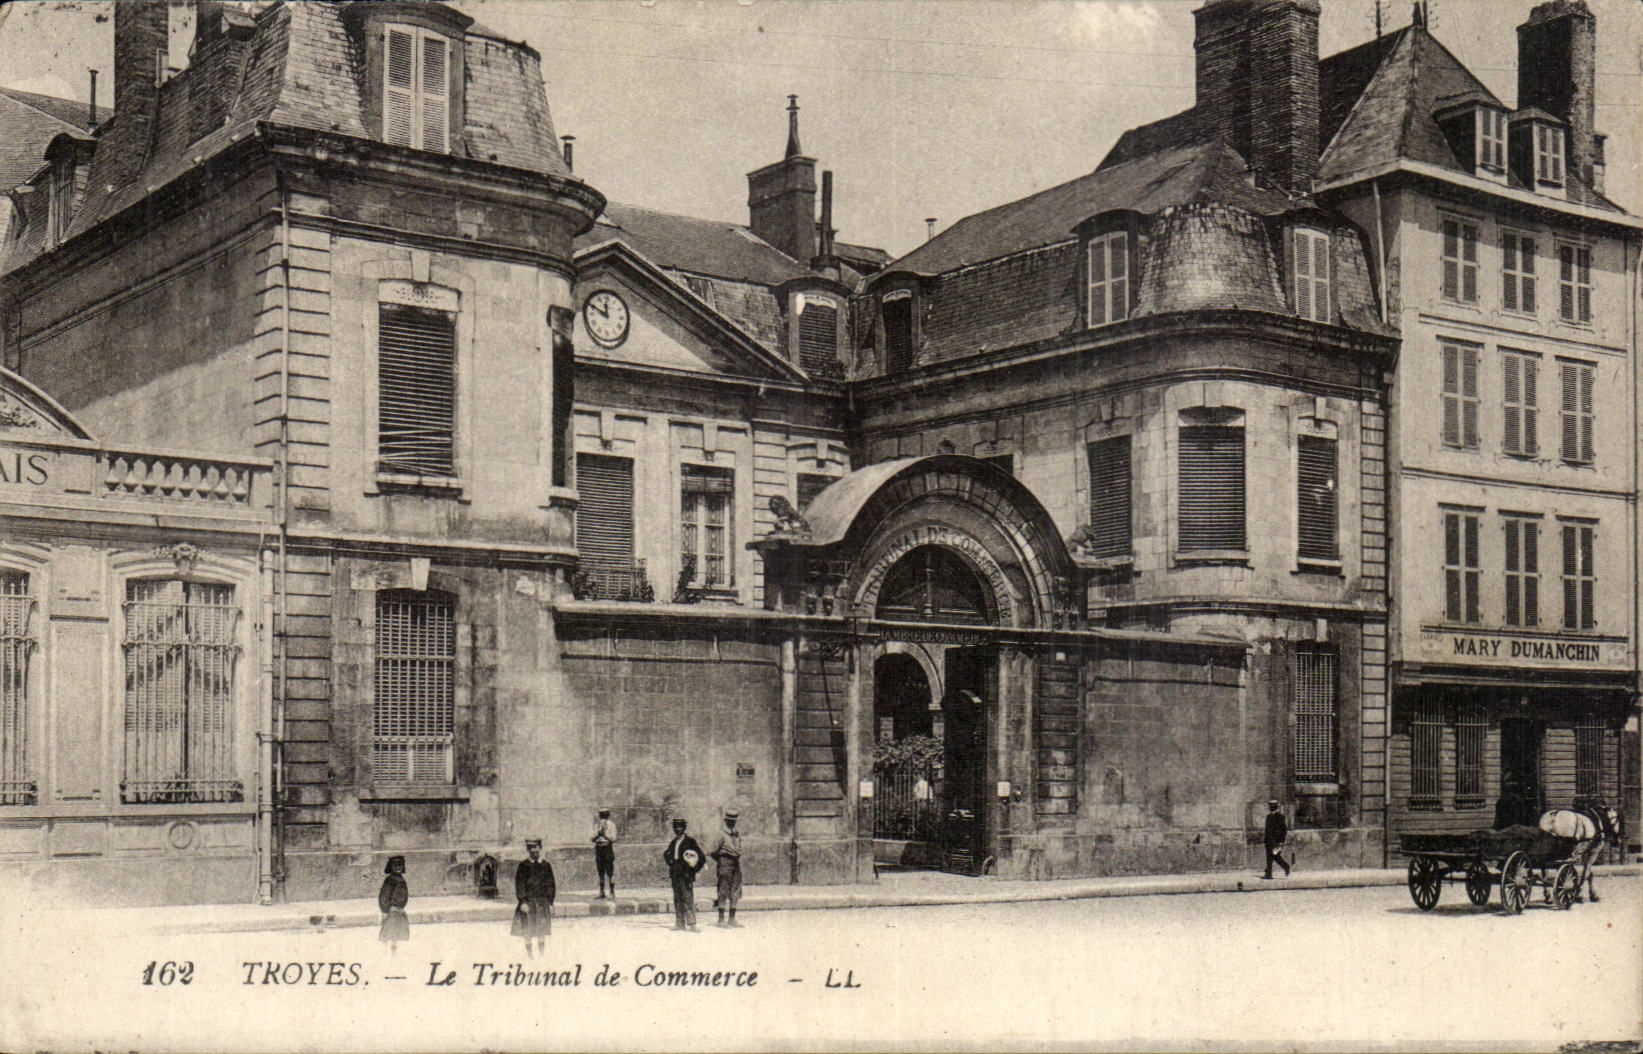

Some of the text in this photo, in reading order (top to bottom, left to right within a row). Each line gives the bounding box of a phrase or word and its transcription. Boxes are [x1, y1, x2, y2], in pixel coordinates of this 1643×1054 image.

[862, 526, 1012, 618] TRIBUNAL DE COMMERCE
[1453, 636, 1501, 656] MARY
[1511, 640, 1600, 661] DUMANCHIN
